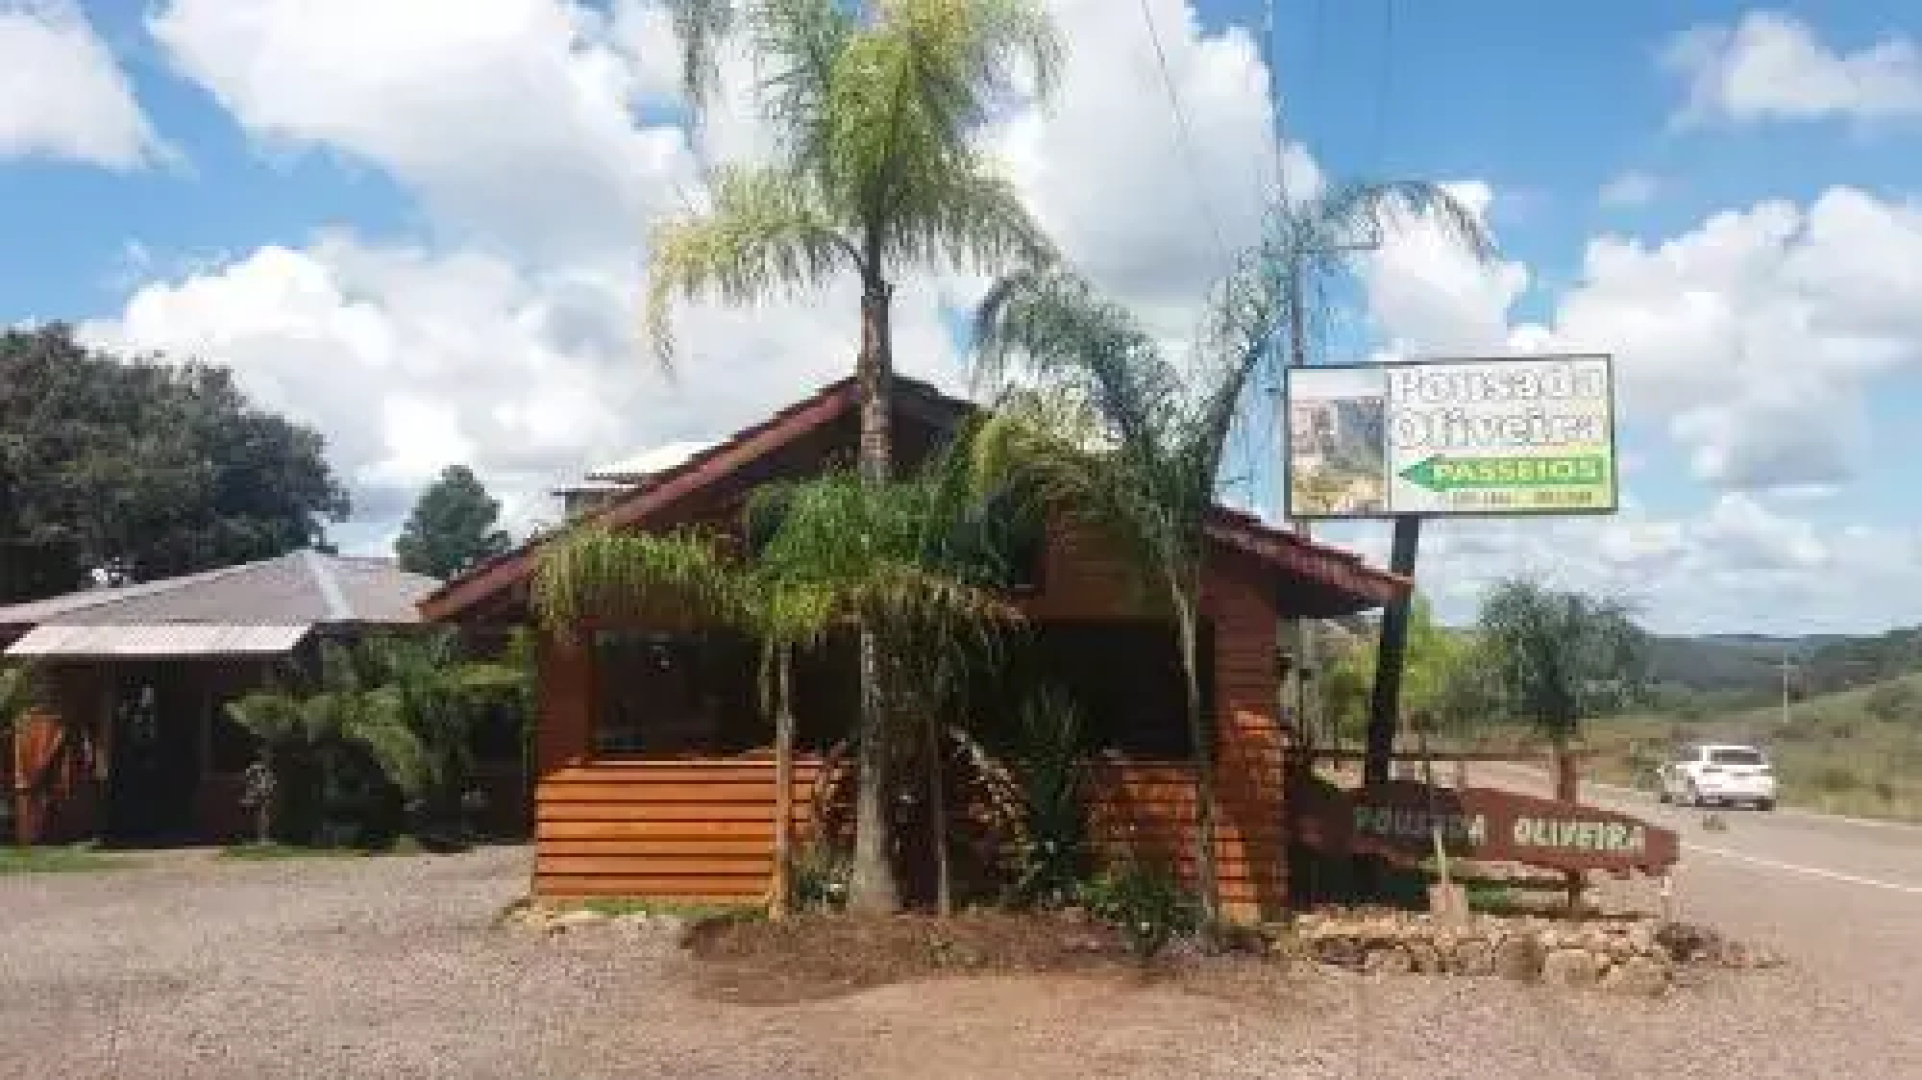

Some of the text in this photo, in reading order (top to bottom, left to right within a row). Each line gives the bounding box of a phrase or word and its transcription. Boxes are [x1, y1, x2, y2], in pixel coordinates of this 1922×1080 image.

[1391, 407, 1603, 446] Oliveira
[1433, 460, 1597, 482] PASSEIOS
[1514, 816, 1646, 856] OLIVEIRA
